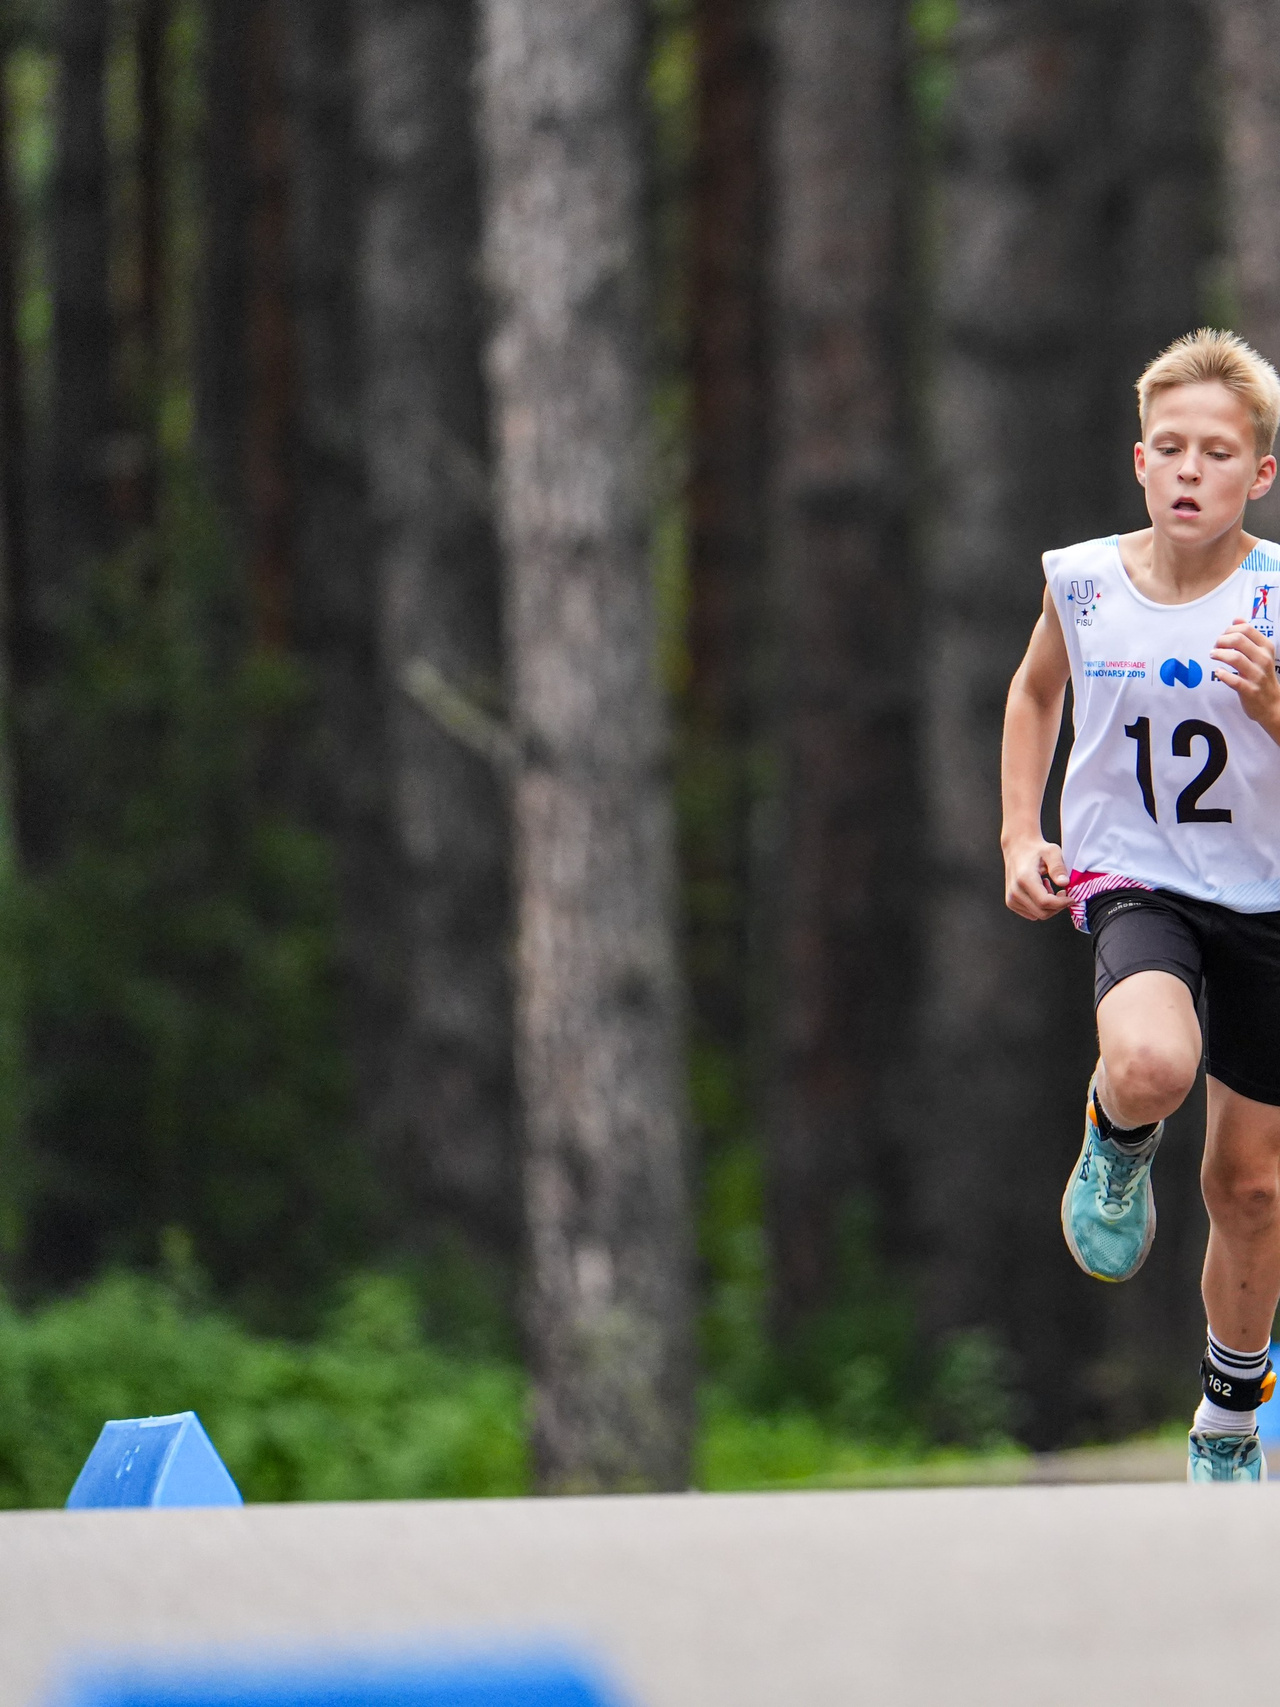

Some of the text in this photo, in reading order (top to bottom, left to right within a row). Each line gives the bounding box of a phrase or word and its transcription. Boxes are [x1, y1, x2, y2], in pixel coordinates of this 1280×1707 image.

[1075, 618, 1093, 627] FISU
[1105, 660, 1146, 669] UNIVERSIADE
[1126, 670, 1146, 679] 2019
[1124, 716, 1233, 825] 12
[1209, 1373, 1233, 1397] 162
